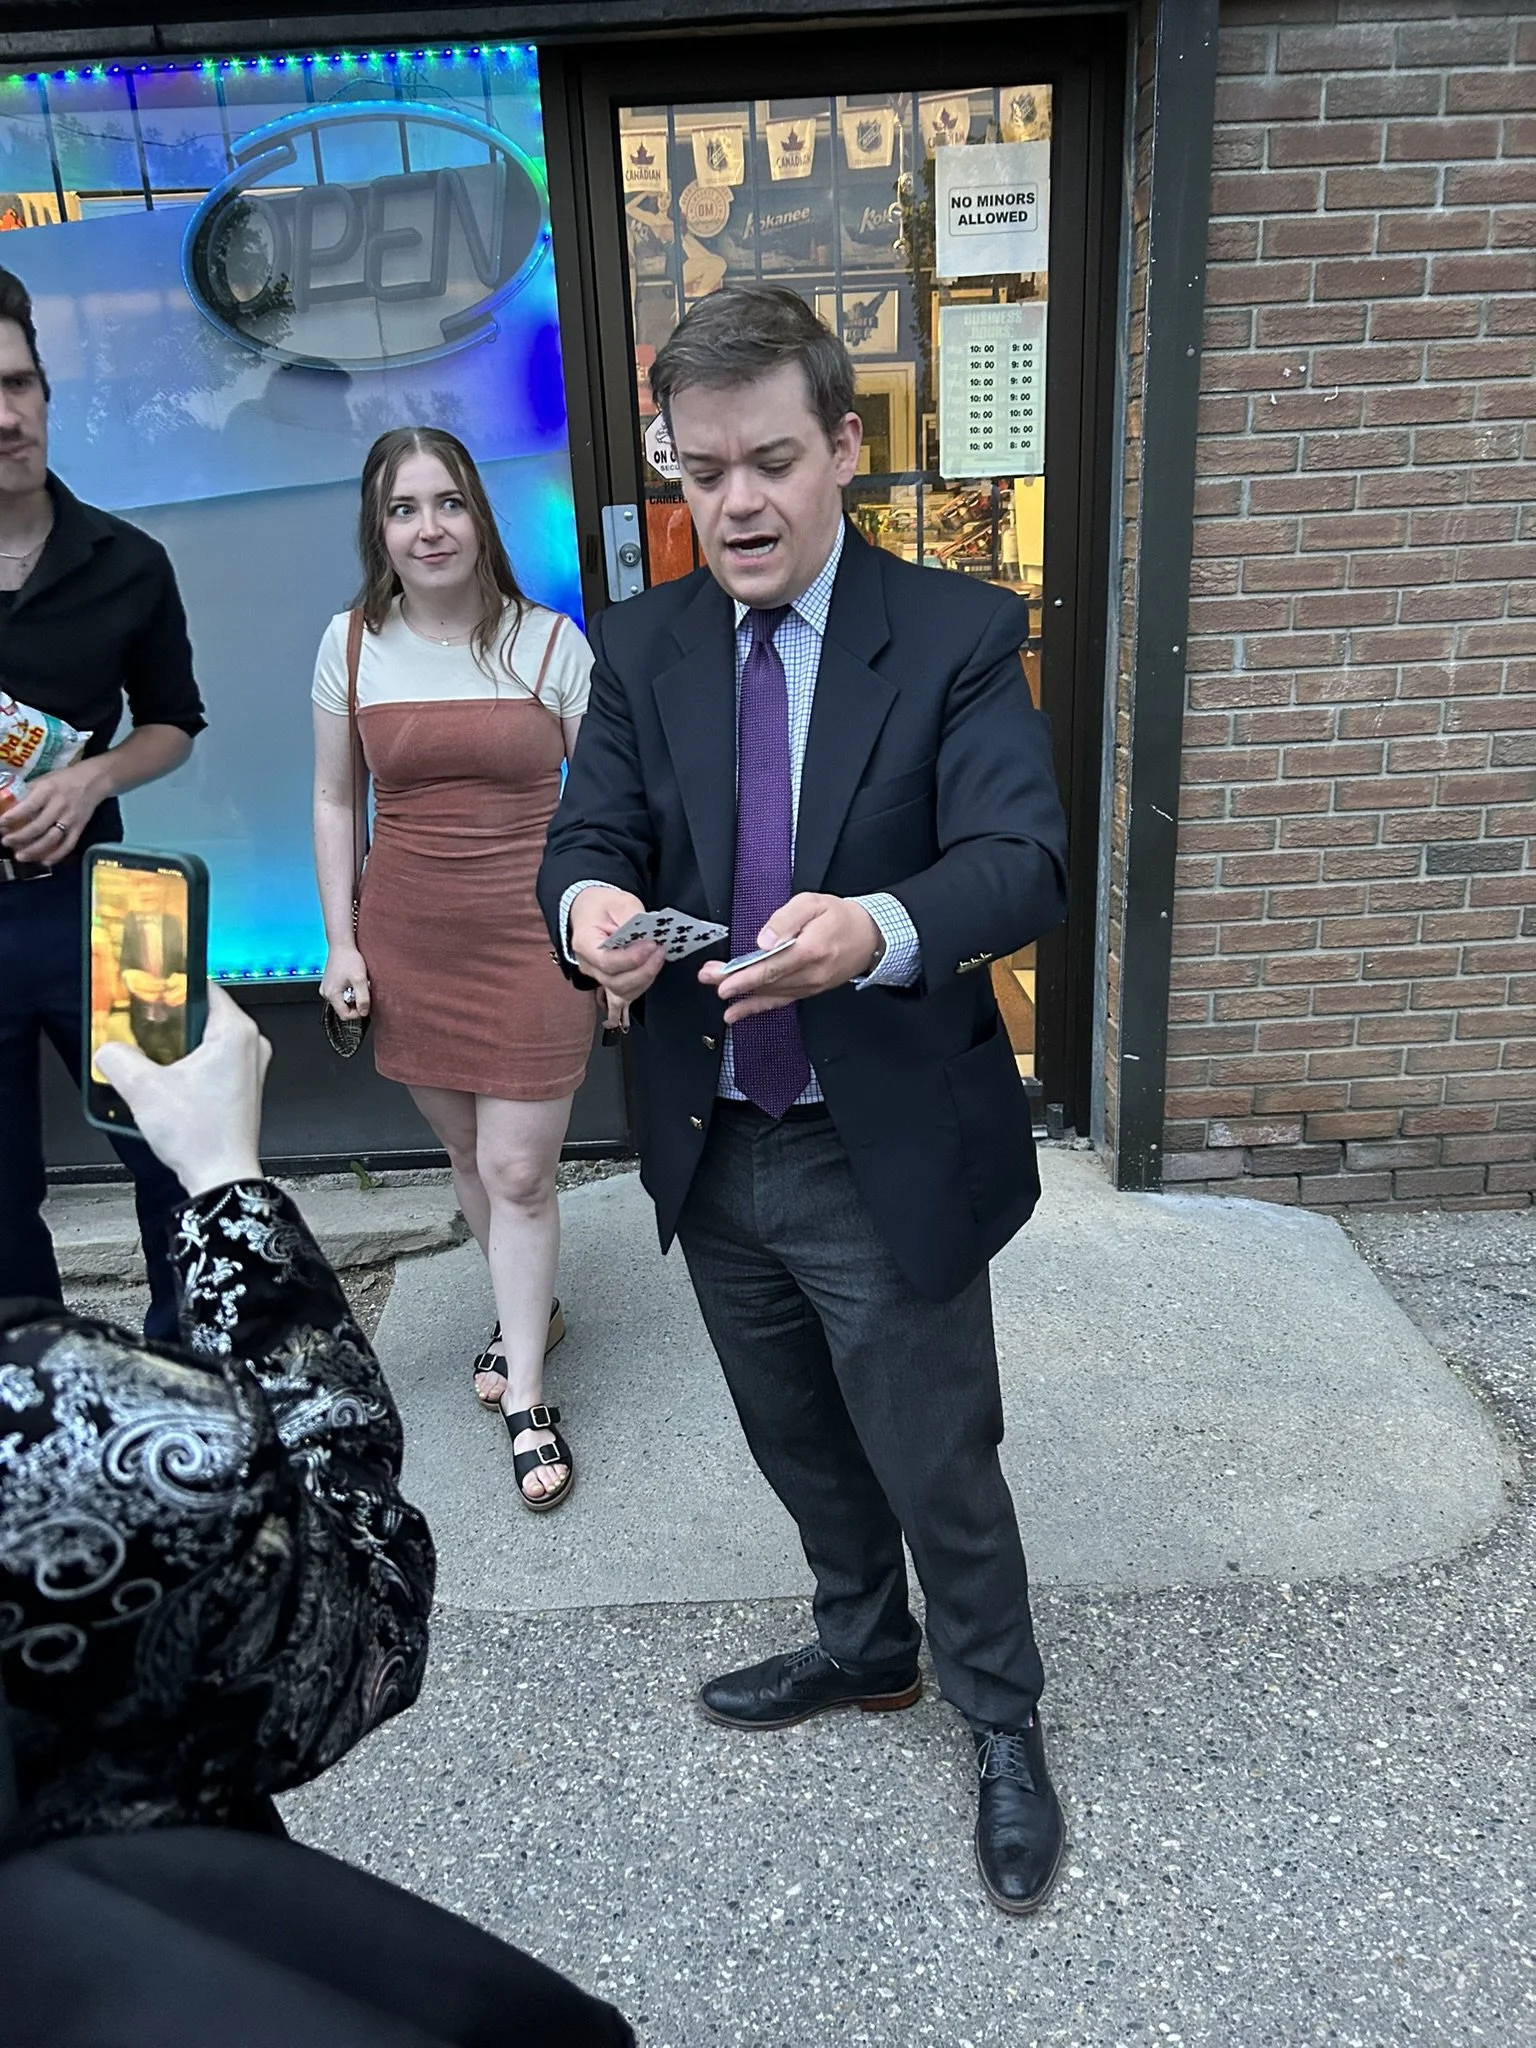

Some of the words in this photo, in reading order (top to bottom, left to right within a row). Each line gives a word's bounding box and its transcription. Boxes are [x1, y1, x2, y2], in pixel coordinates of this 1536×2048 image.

[625, 169, 661, 182] CANADIAN
[951, 196, 972, 209] NO
[977, 192, 1035, 207] MINORS
[958, 210, 1028, 226] ALLOWED
[207, 156, 508, 311] OPEN
[653, 450, 668, 463] ON
[649, 494, 688, 505] CAMER
